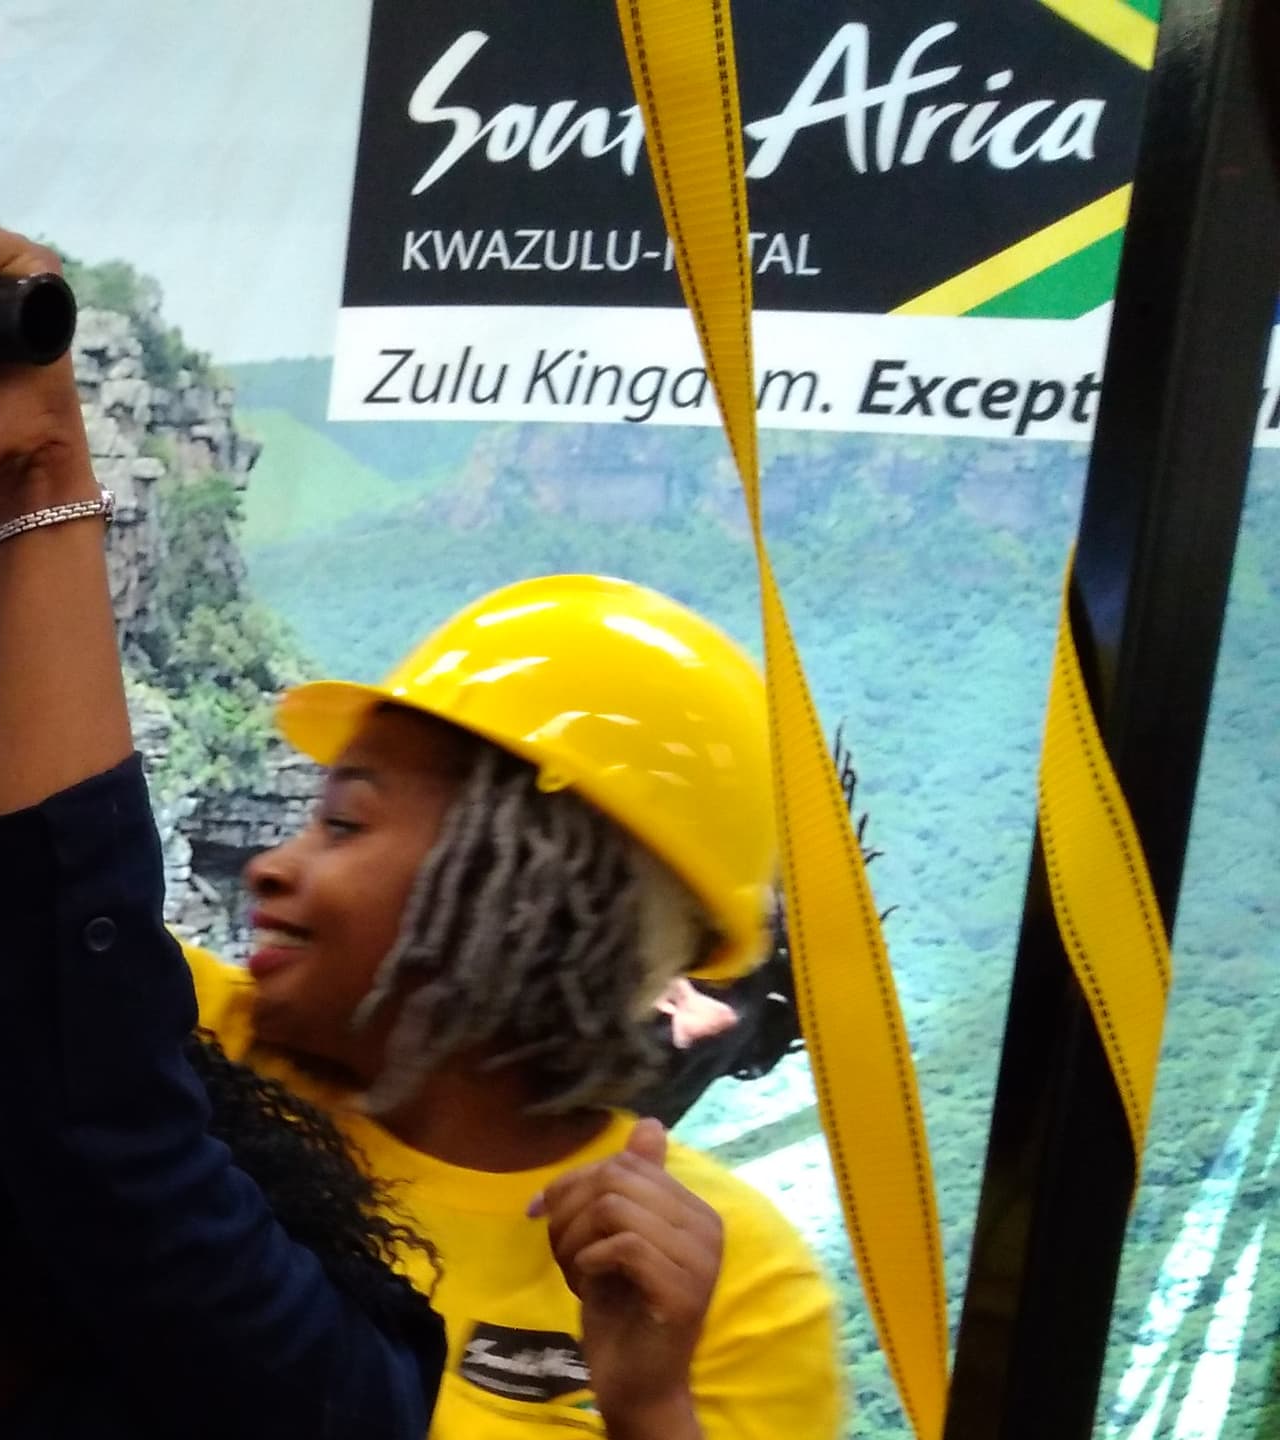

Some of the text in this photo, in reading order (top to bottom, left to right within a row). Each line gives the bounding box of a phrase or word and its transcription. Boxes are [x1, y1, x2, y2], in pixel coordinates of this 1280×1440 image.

[743, 21, 1107, 178] Africa
[364, 347, 508, 407] Zulu
[523, 350, 833, 424] Kingdm.
